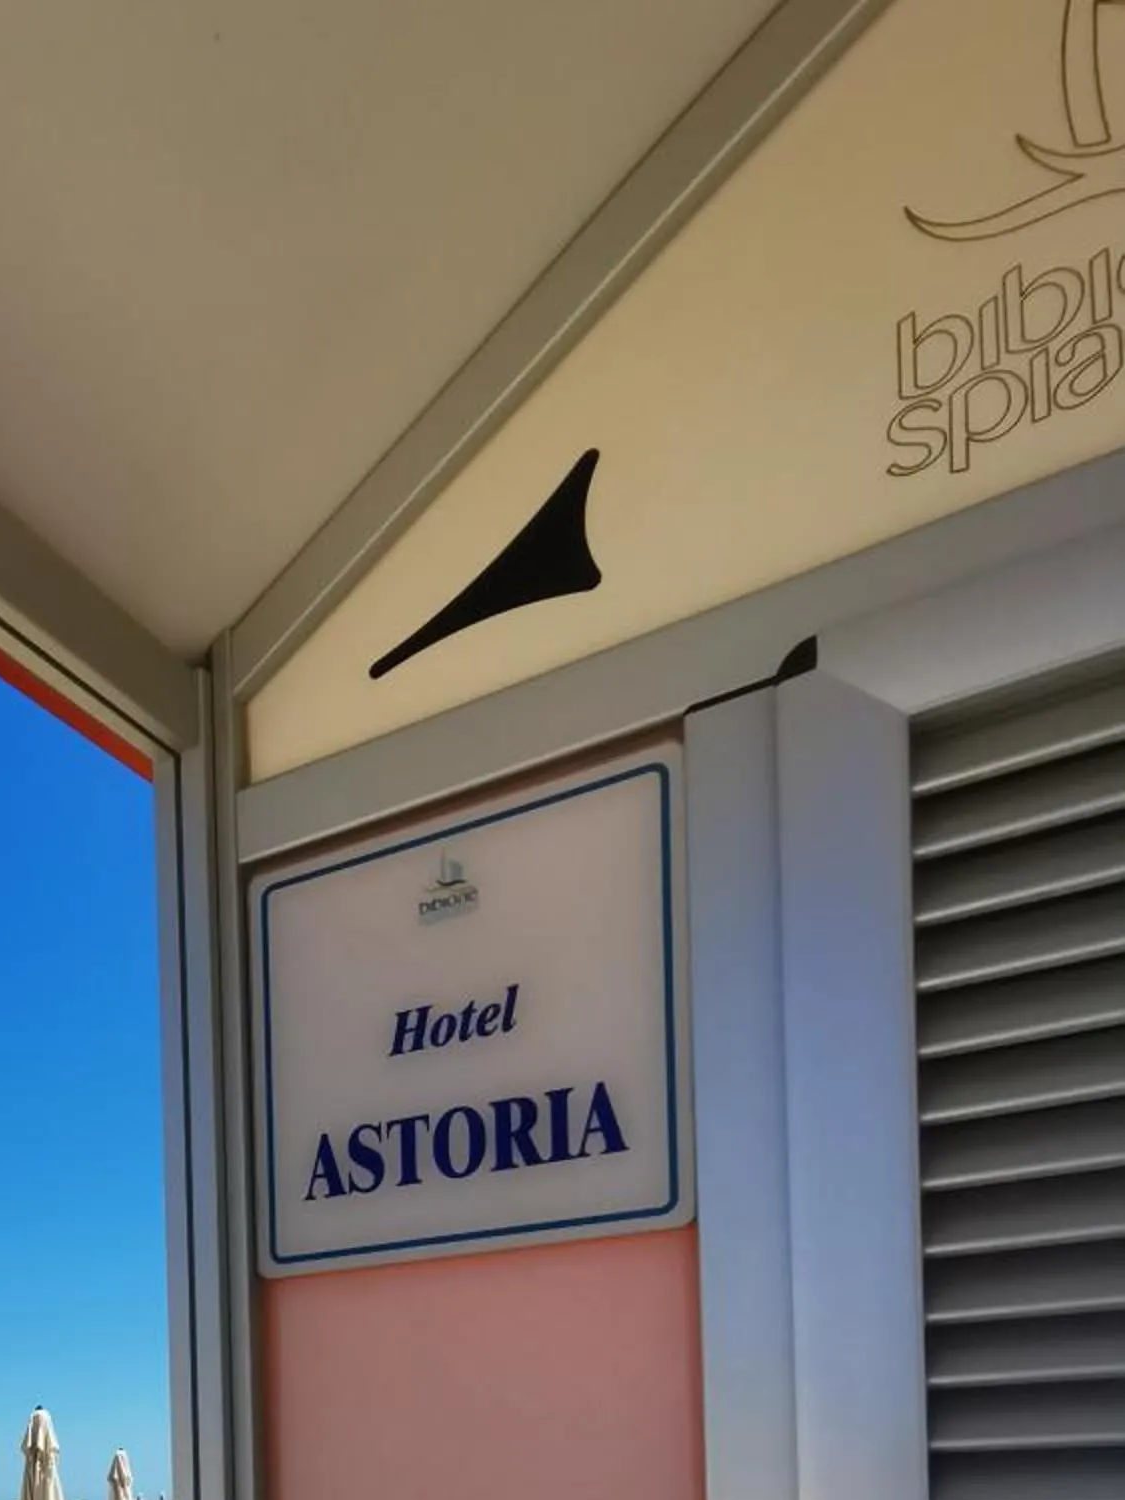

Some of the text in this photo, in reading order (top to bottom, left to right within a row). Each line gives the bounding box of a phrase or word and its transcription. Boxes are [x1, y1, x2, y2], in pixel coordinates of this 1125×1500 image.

[896, 246, 1125, 401] bibi
[388, 984, 520, 1057] Hotel
[304, 1081, 629, 1201] ASTORIA
